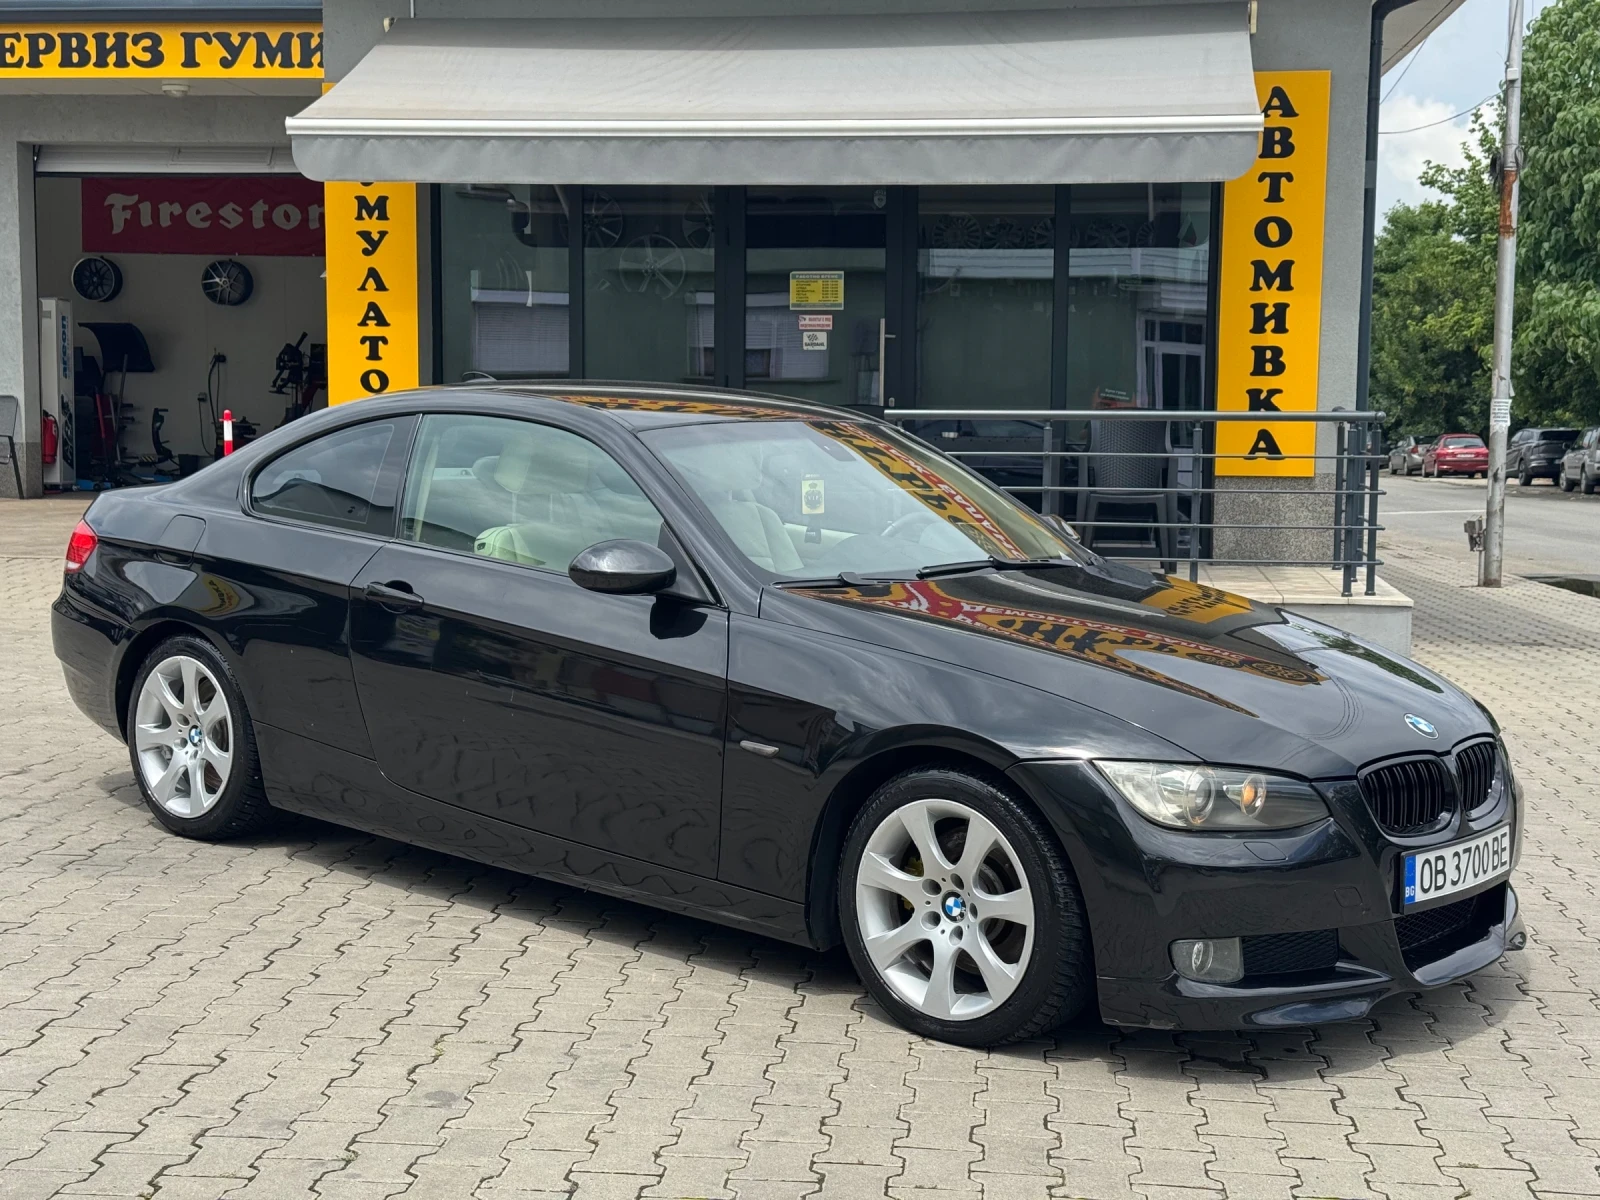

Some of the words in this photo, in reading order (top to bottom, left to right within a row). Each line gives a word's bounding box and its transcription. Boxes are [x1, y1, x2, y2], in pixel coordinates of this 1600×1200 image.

[0, 32, 165, 68] ЕРВИЗ
[181, 32, 324, 68] ГУМИ
[354, 182, 391, 394] МУЛАТО
[1242, 86, 1300, 460] АВТОМИВКА
[1405, 886, 1415, 897] BG
[1420, 854, 1448, 894] OB
[1450, 841, 1489, 886] 3700
[1491, 832, 1508, 871] BE
